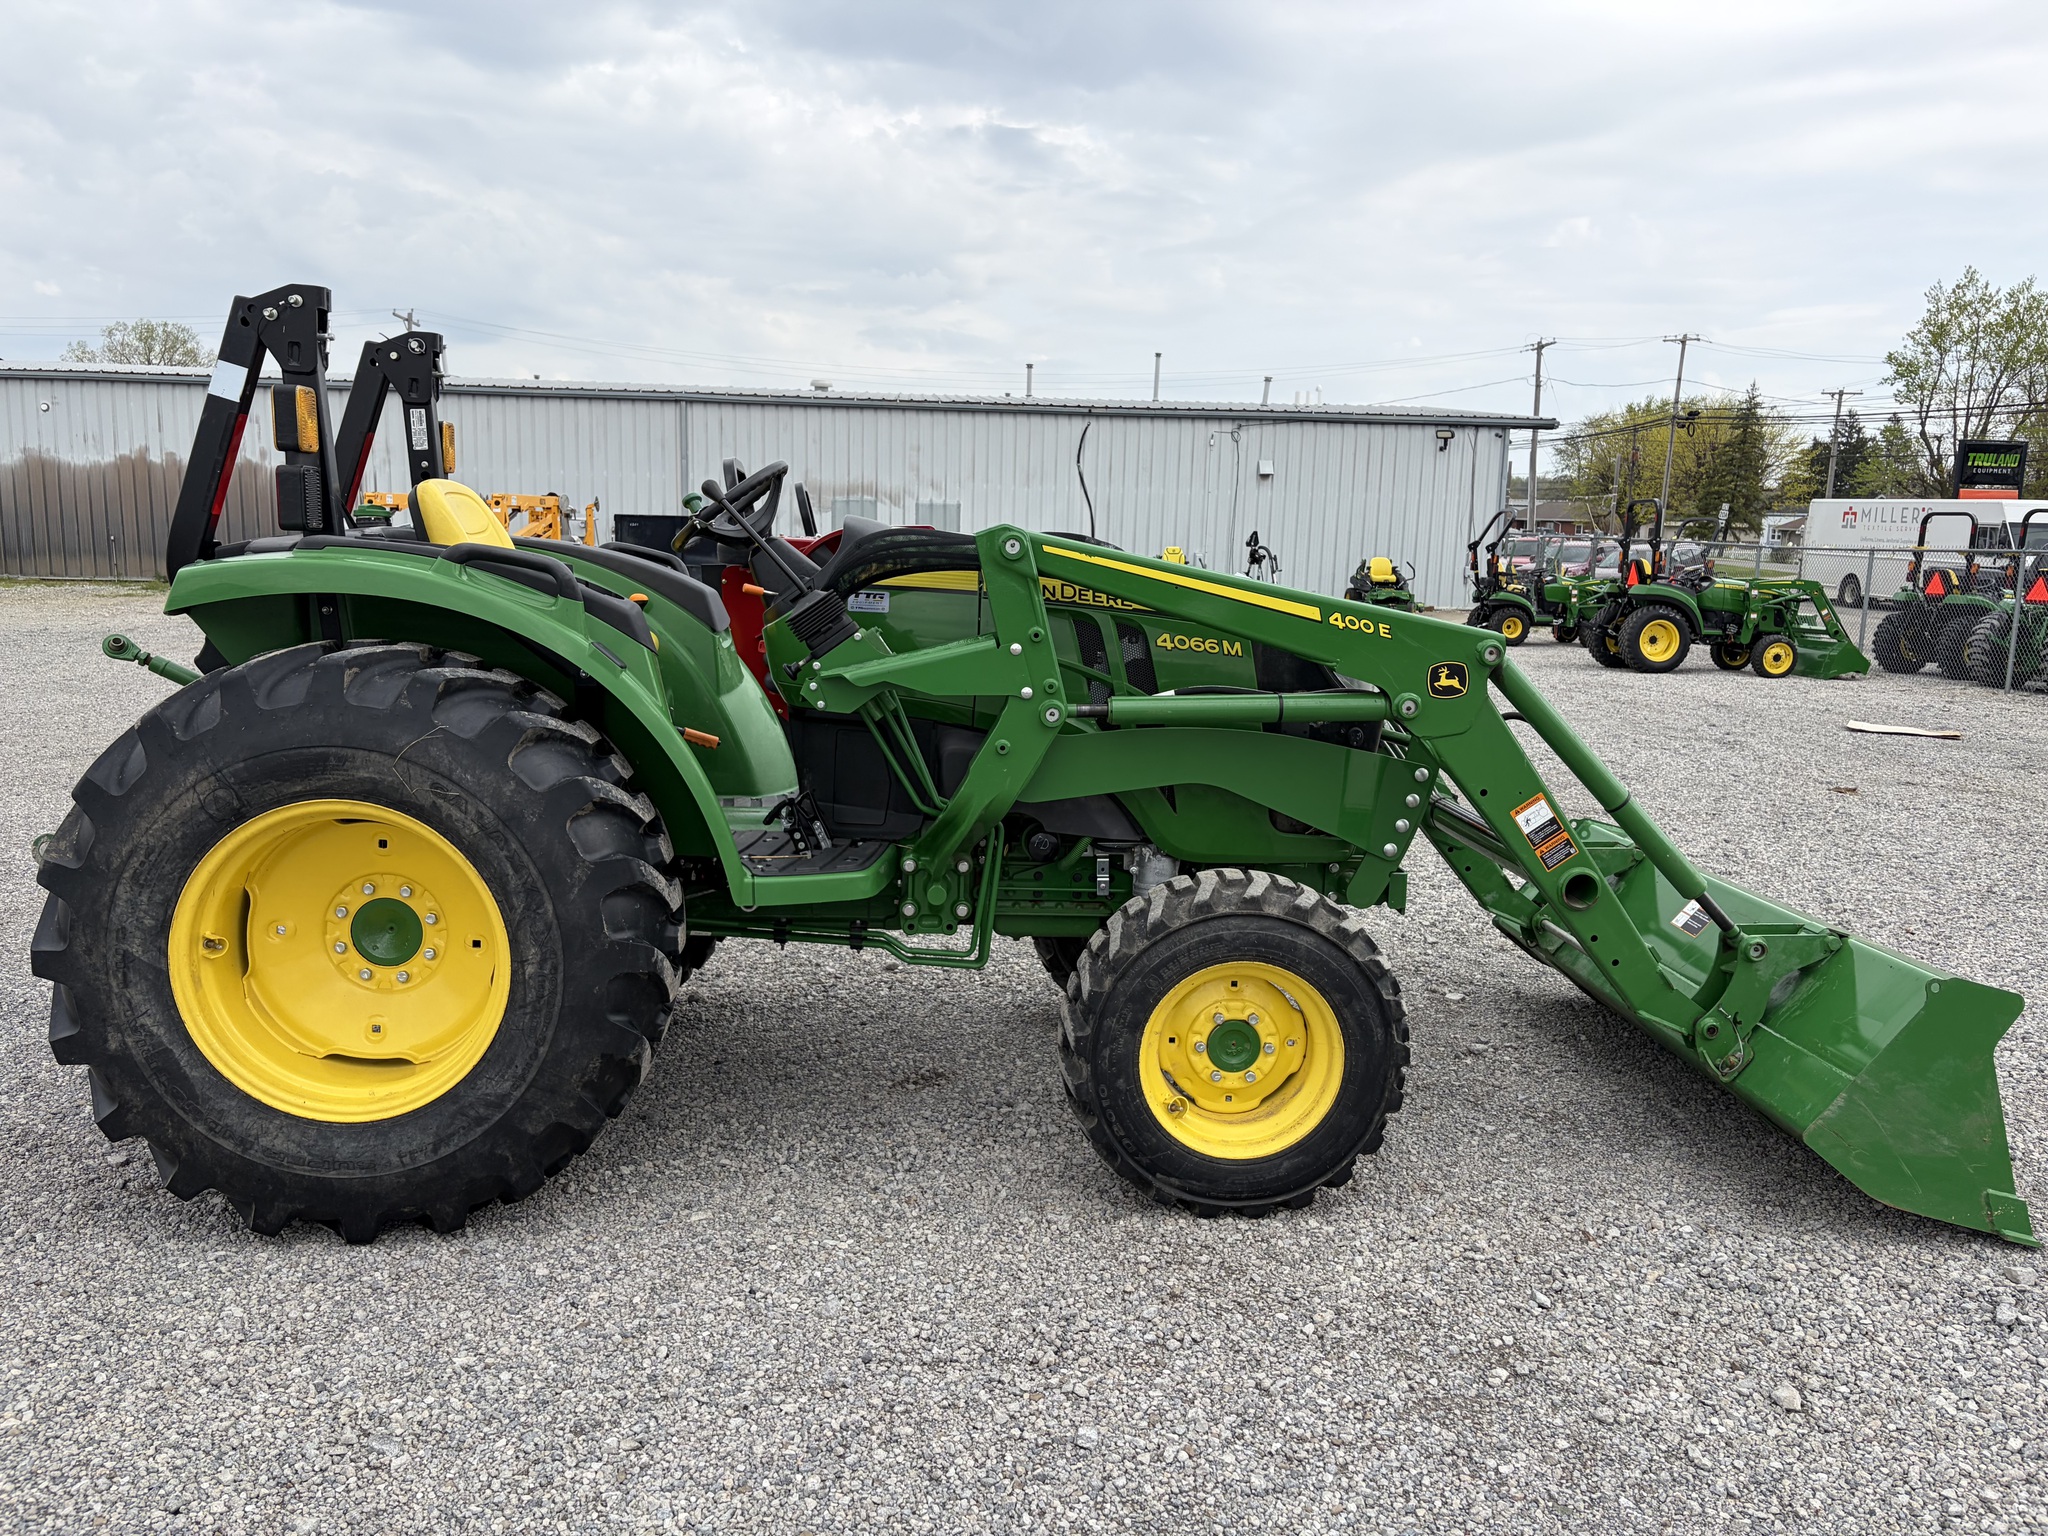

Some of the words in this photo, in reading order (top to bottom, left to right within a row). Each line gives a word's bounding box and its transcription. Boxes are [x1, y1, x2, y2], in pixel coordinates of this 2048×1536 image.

[1967, 452, 2020, 467] TRULAND
[1863, 524, 1892, 532] TEXTILE
[1328, 612, 1375, 635] 400
[1378, 622, 1392, 639] E
[1156, 633, 1220, 655] 4066
[1222, 640, 1244, 657] M
[1519, 796, 1541, 812] WARNING
[1544, 835, 1566, 851] WARNING
